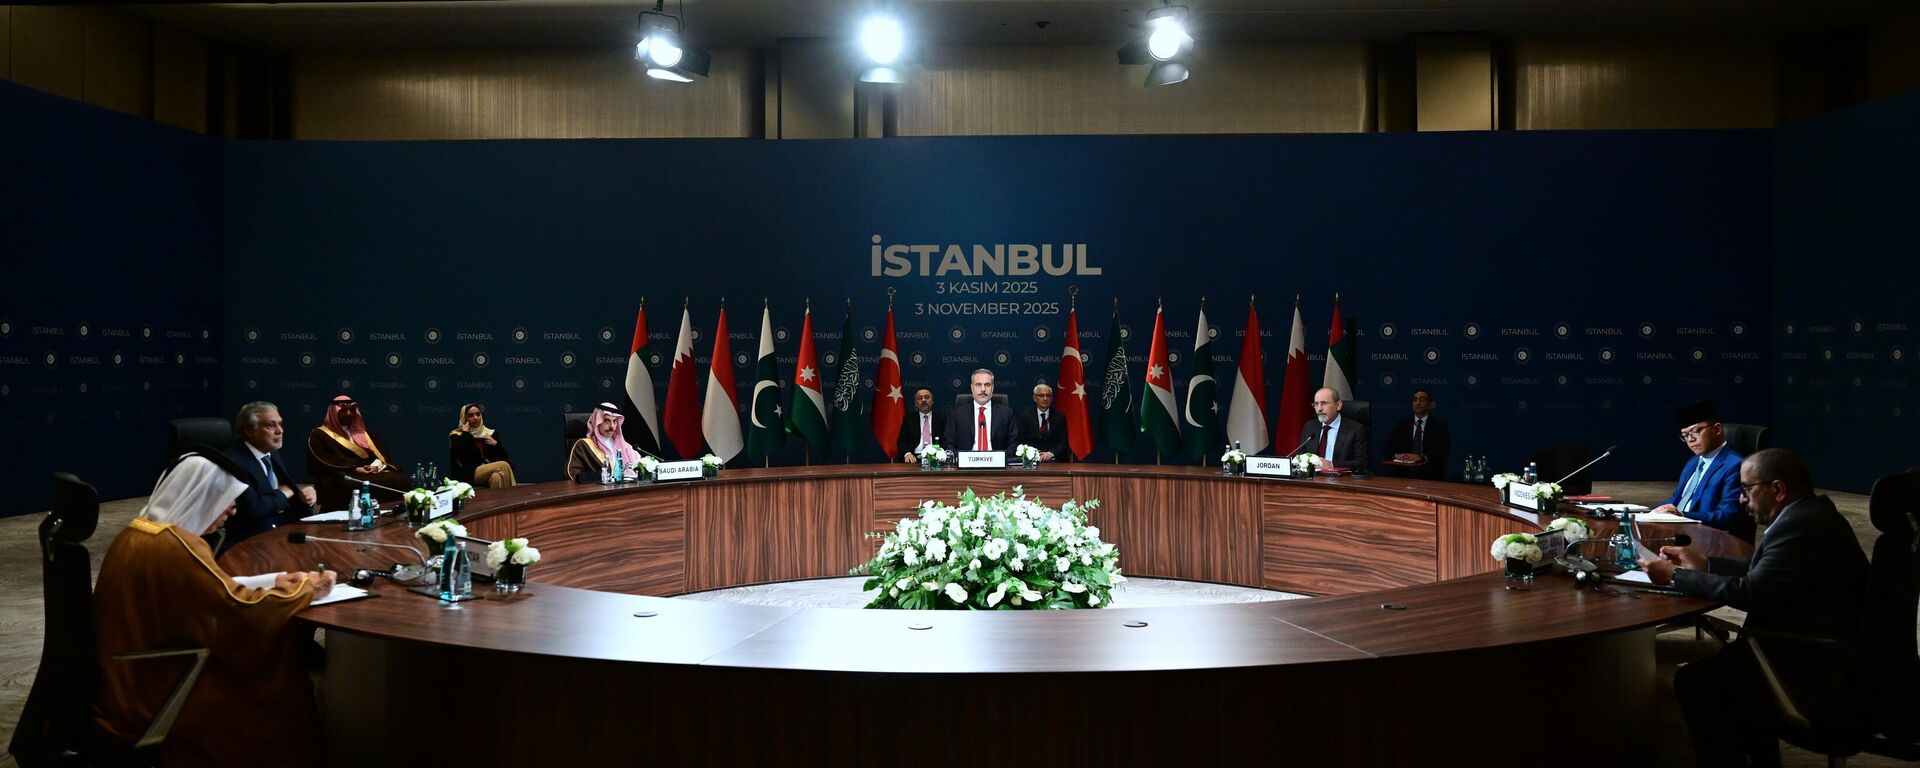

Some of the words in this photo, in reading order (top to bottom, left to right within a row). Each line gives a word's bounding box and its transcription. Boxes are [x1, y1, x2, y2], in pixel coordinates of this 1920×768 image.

[871, 234, 1102, 277] İSTANBUL
[936, 282, 945, 294] 3
[949, 282, 997, 294] KASIM
[1002, 281, 1038, 294] 2025
[914, 303, 924, 315] 3
[928, 302, 1020, 315] NOVEMBER
[1023, 302, 1060, 314] 2025
[659, 467, 677, 475] SAUDI
